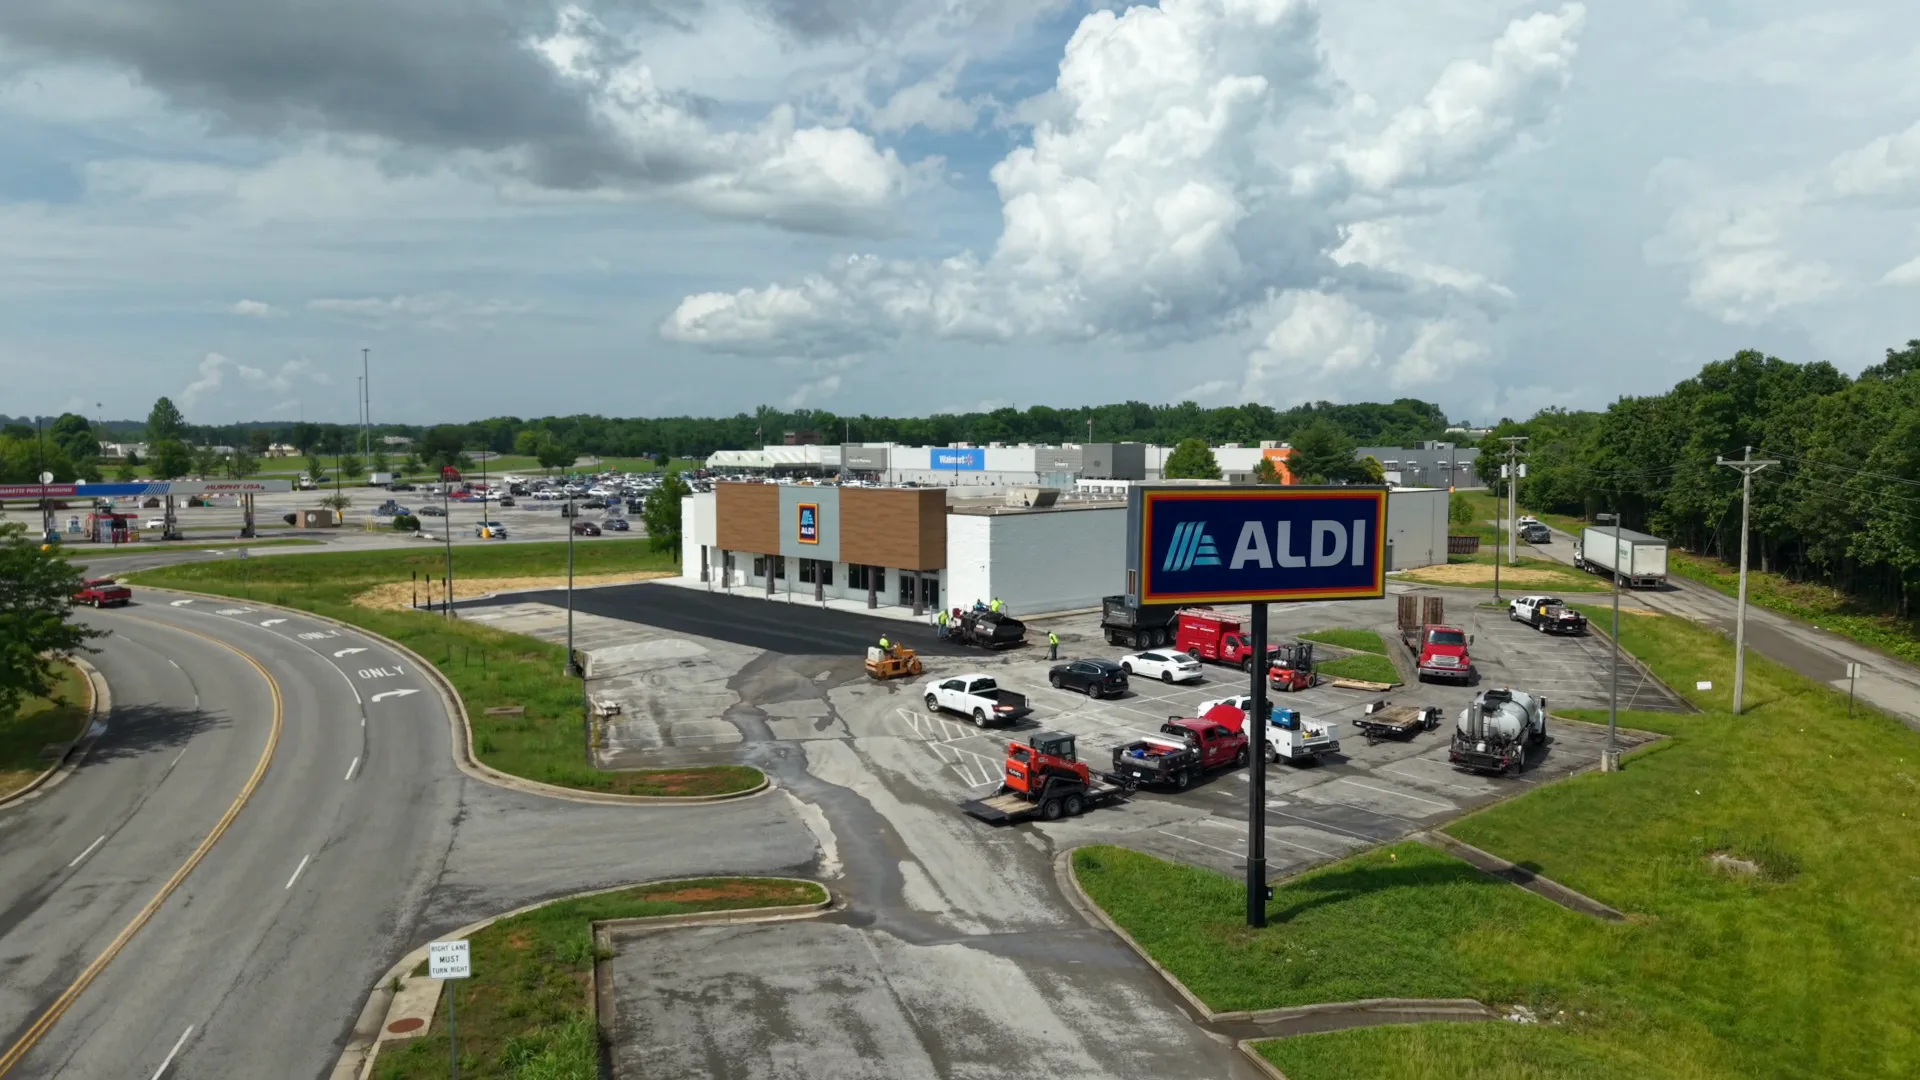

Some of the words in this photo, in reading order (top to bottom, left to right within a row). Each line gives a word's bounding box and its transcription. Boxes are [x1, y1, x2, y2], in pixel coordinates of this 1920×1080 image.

[939, 455, 965, 464] Walmart
[800, 526, 815, 535] ALDI
[1229, 519, 1366, 570] ALDI
[297, 630, 342, 640] ONLY
[358, 664, 405, 679] ONLY
[439, 955, 459, 964] MUST
[432, 967, 448, 975] TURN
